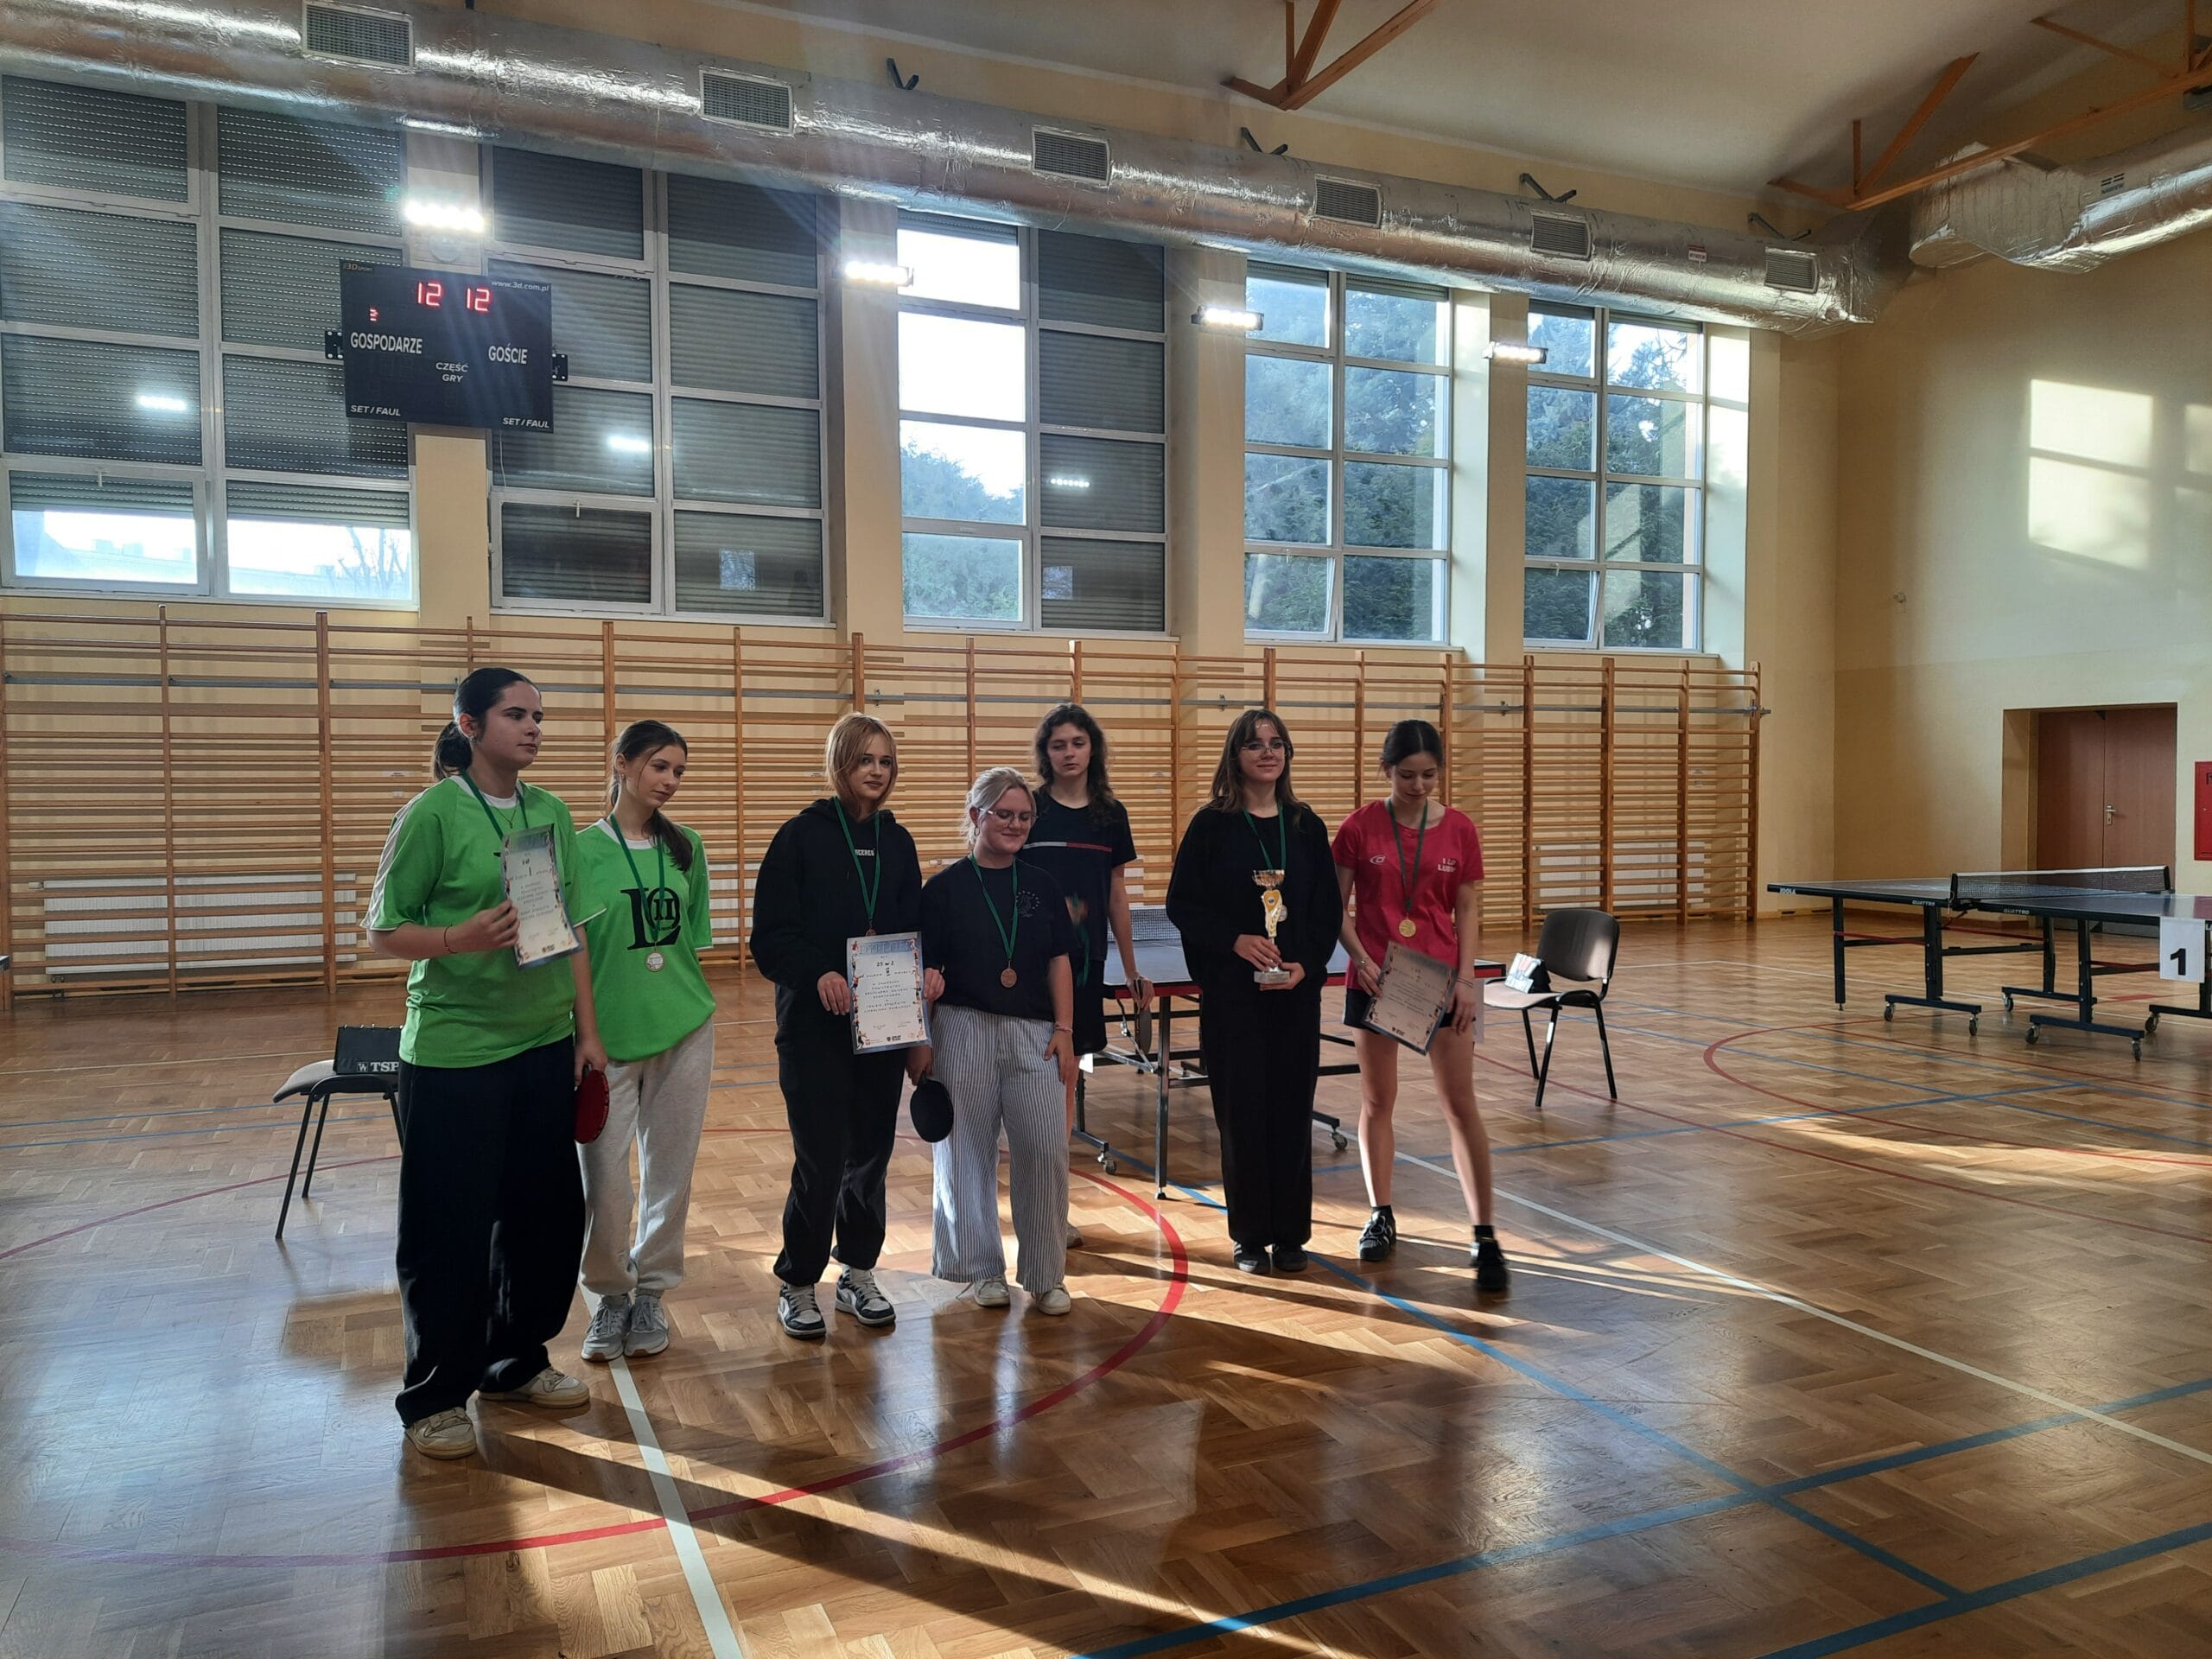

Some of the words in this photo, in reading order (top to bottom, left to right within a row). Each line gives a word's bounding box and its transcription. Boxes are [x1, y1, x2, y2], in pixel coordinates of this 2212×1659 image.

[491, 280, 550, 292] www.3d.com.pl
[416, 282, 442, 306] 12
[467, 287, 490, 312] 12
[350, 332, 423, 354] GOSPODARZE
[488, 343, 528, 364] GOŚCIE
[435, 362, 469, 373] CZĘŚĆ
[442, 373, 463, 383] GRY
[350, 404, 370, 414] SET
[376, 407, 401, 416] FAUL
[503, 417, 521, 426] SET
[525, 419, 550, 429] FAUL
[2170, 948, 2186, 976] 1
[370, 1061, 399, 1072] TSP
